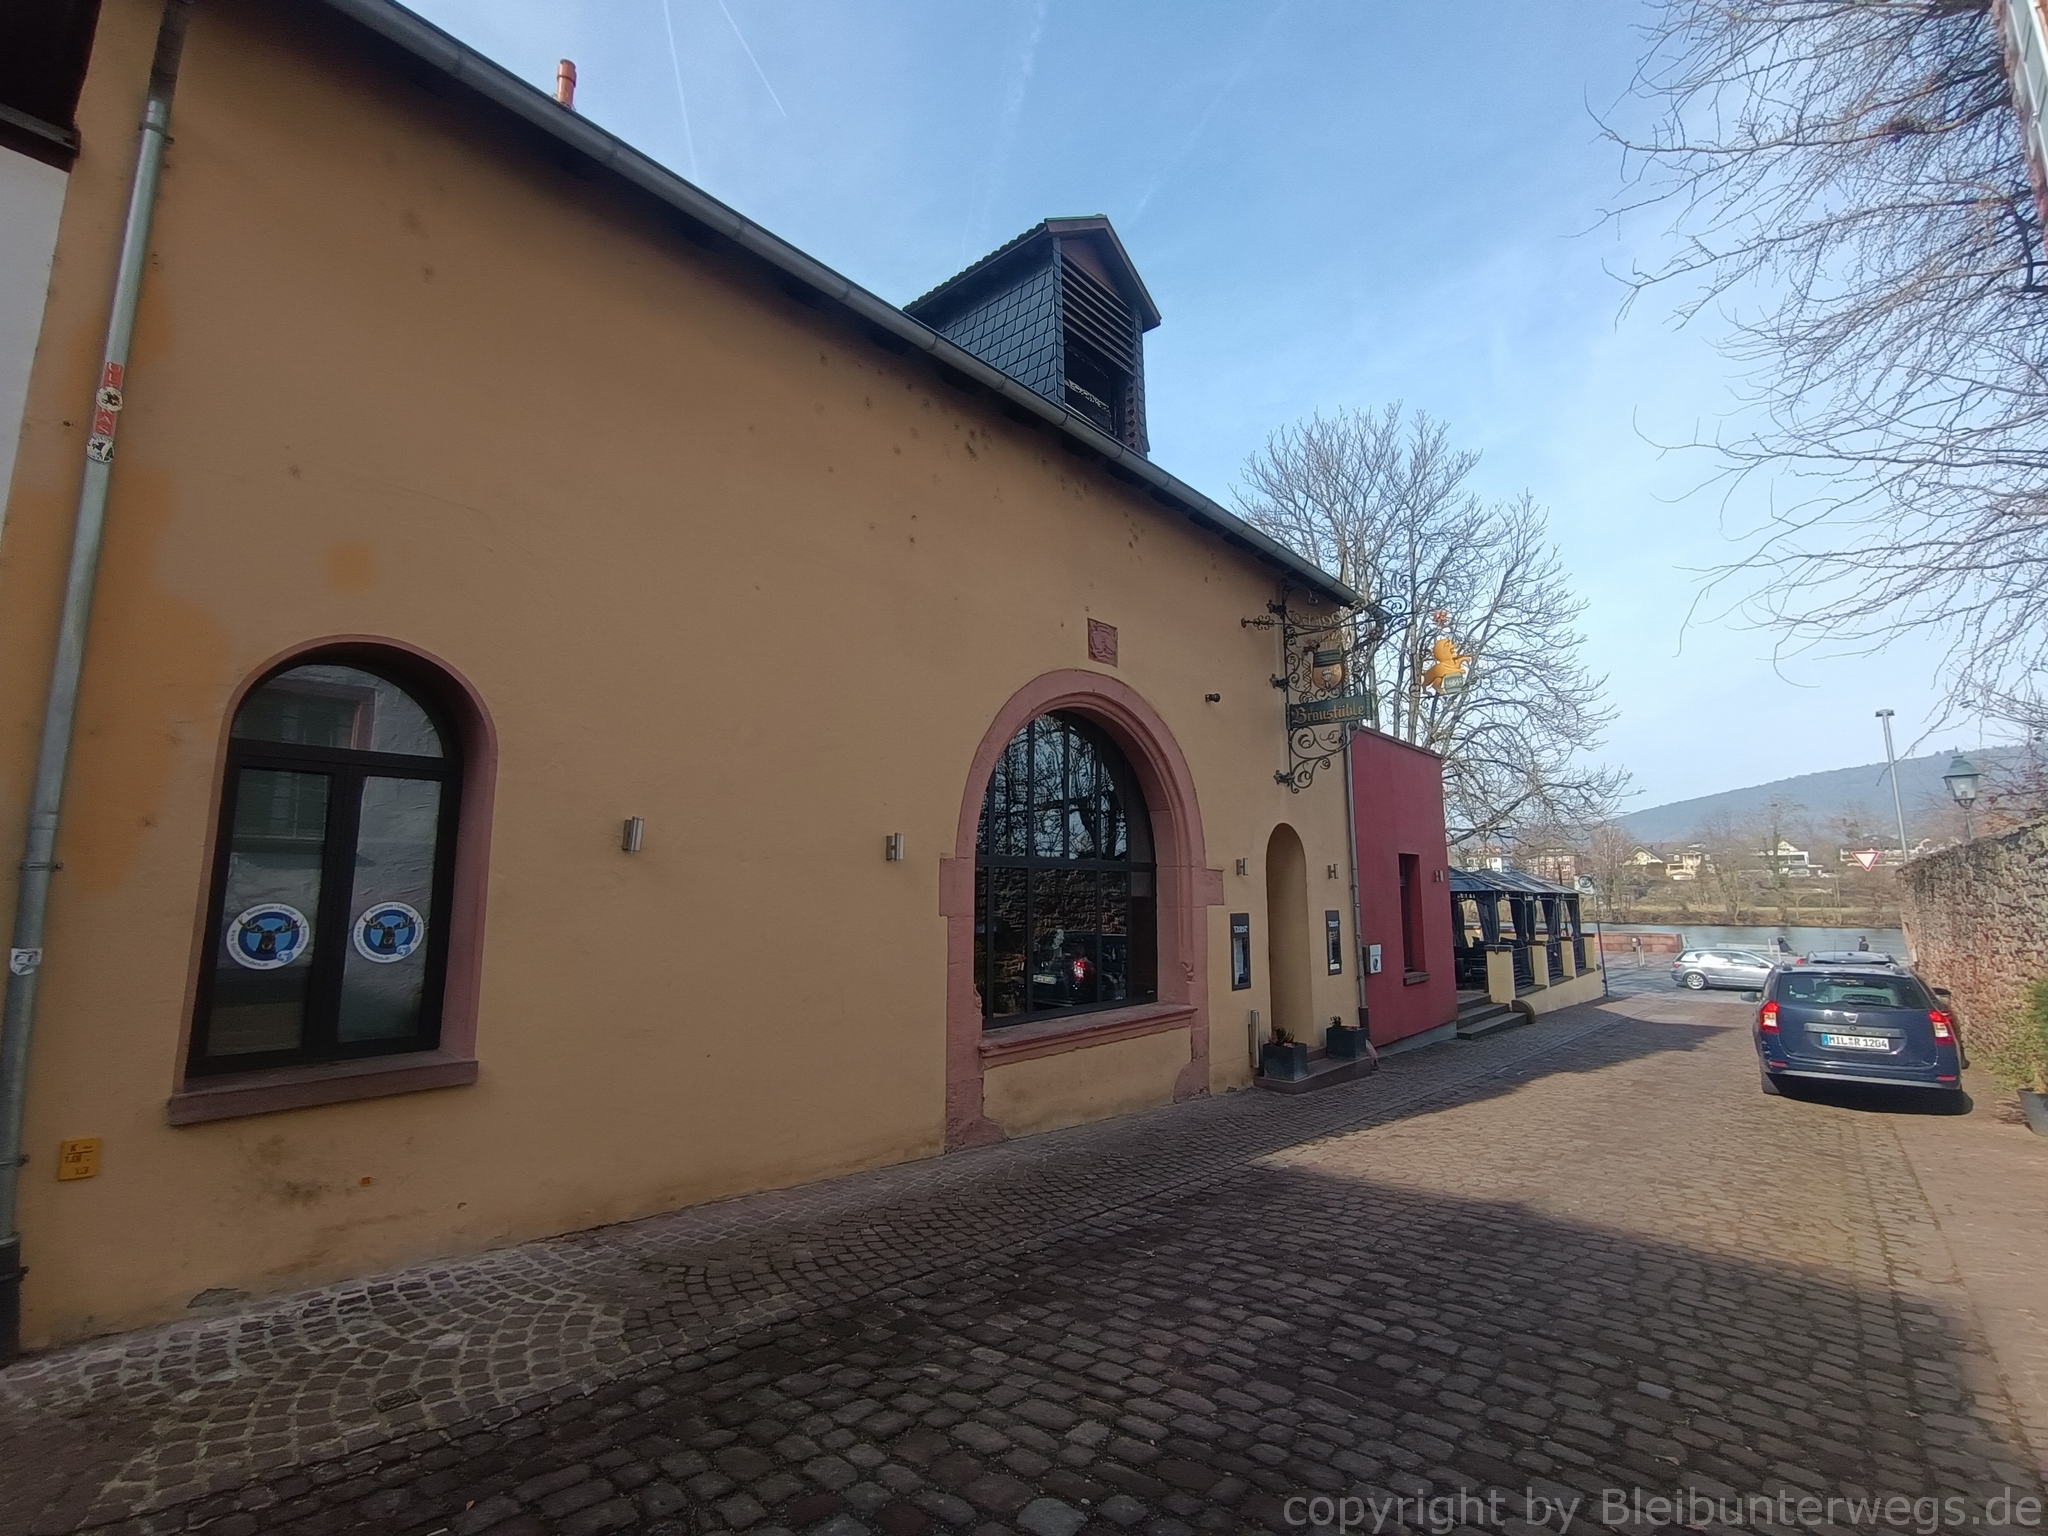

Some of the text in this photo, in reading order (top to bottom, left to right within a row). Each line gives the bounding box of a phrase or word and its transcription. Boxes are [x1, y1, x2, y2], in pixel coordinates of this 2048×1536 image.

[1829, 1036, 1888, 1048] MIL R 1204
